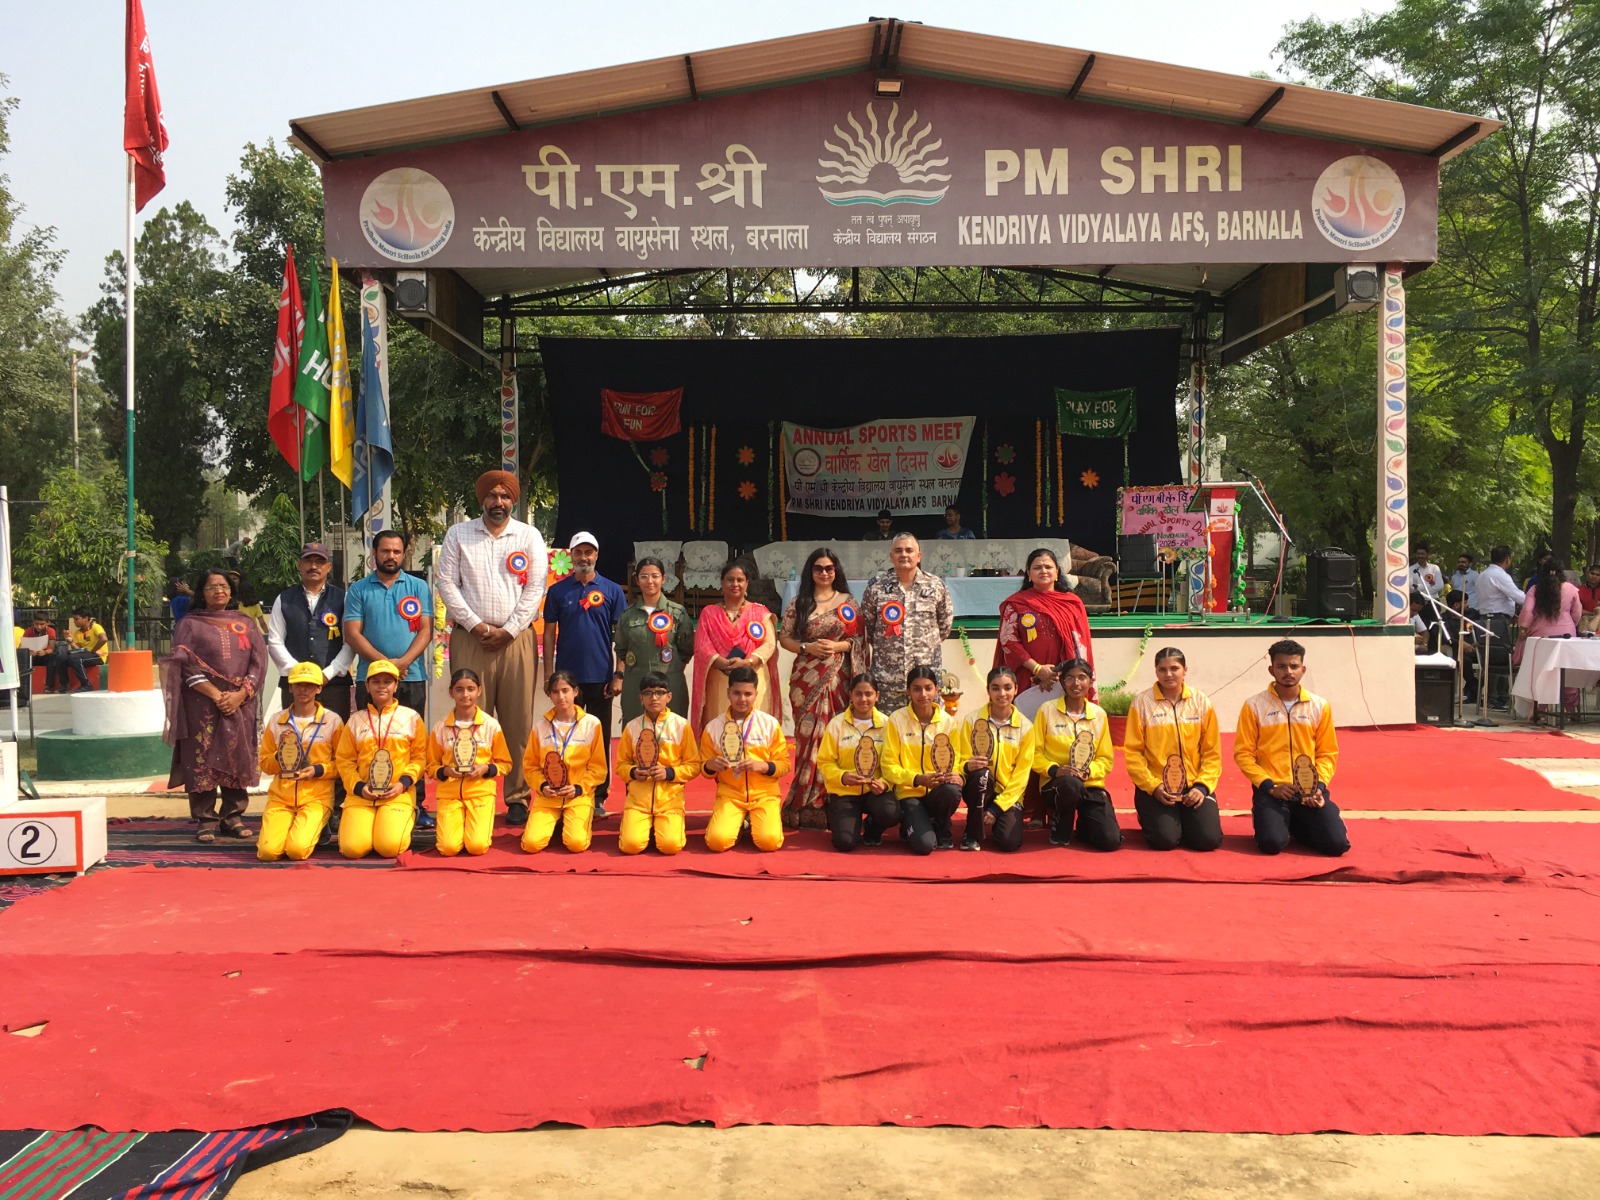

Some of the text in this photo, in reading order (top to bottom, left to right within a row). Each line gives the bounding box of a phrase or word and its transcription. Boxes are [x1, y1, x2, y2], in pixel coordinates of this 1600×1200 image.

[984, 145, 1242, 196] PM SHRI
[363, 220, 379, 245] Pradhan
[378, 242, 397, 257] Mantri
[429, 235, 446, 252] Rising
[442, 220, 453, 239] India
[473, 216, 809, 260] केन्द्रीय विद्यालय वायुसेना स्थल, बरनाला
[833, 228, 937, 244] केन्द्रीय विद्यालय संगठन
[958, 209, 1303, 248] KENDRIYA VIDYALAYA AFS, BARNALA
[1315, 208, 1330, 233] Pradhan
[1328, 232, 1348, 246] Mantri
[1380, 223, 1397, 240] Rising
[1393, 207, 1403, 227] India
[636, 405, 656, 416] FOR
[1094, 400, 1117, 414] FOR
[623, 418, 643, 430] FUN
[793, 422, 963, 446] ANNUAL SPORTS MEET
[1073, 418, 1115, 430] FITNESS
[825, 445, 929, 476] वार्षिक खेल दिवस
[831, 479, 855, 494] केन्द्रीय
[858, 478, 886, 493] विद्यालय
[889, 476, 916, 495] वायुसेना
[919, 479, 935, 491] स्थल
[805, 498, 823, 510] SHRI
[825, 498, 865, 511] KENDRIYA
[867, 496, 910, 510] VIDYALAYA
[912, 495, 927, 509] AFS
[21, 825, 41, 858] 2
